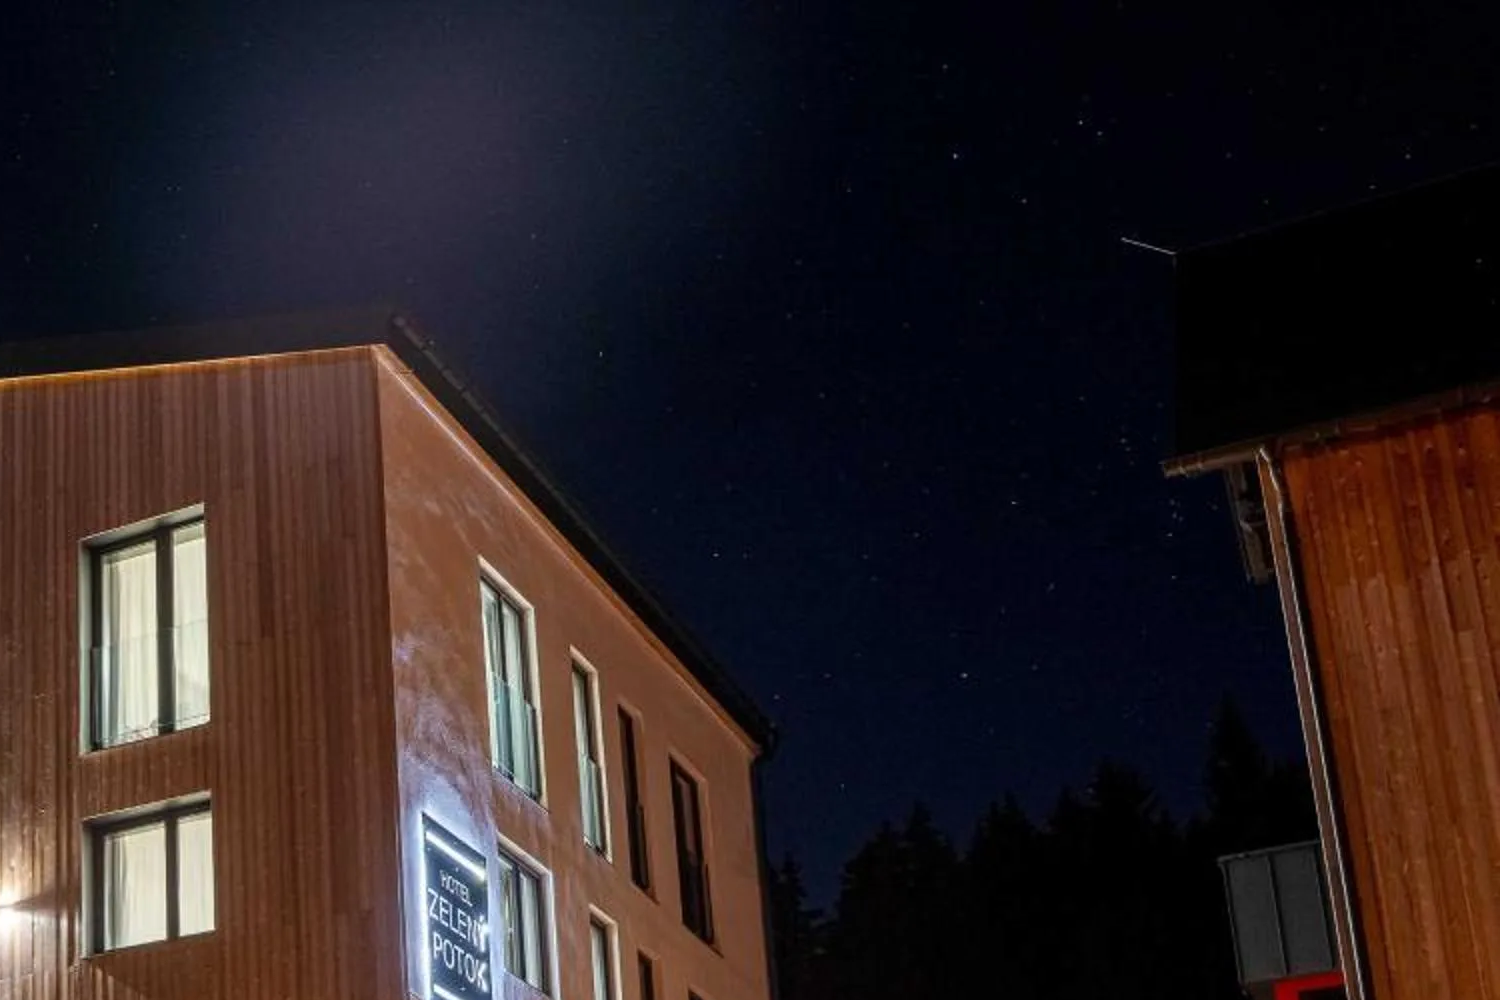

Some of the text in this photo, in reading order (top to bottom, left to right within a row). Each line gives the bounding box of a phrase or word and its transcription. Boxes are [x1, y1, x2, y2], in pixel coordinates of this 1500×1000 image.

[440, 869, 473, 907] HOTEL
[428, 887, 487, 952] ZELENÝ
[433, 931, 488, 992] POTOK
